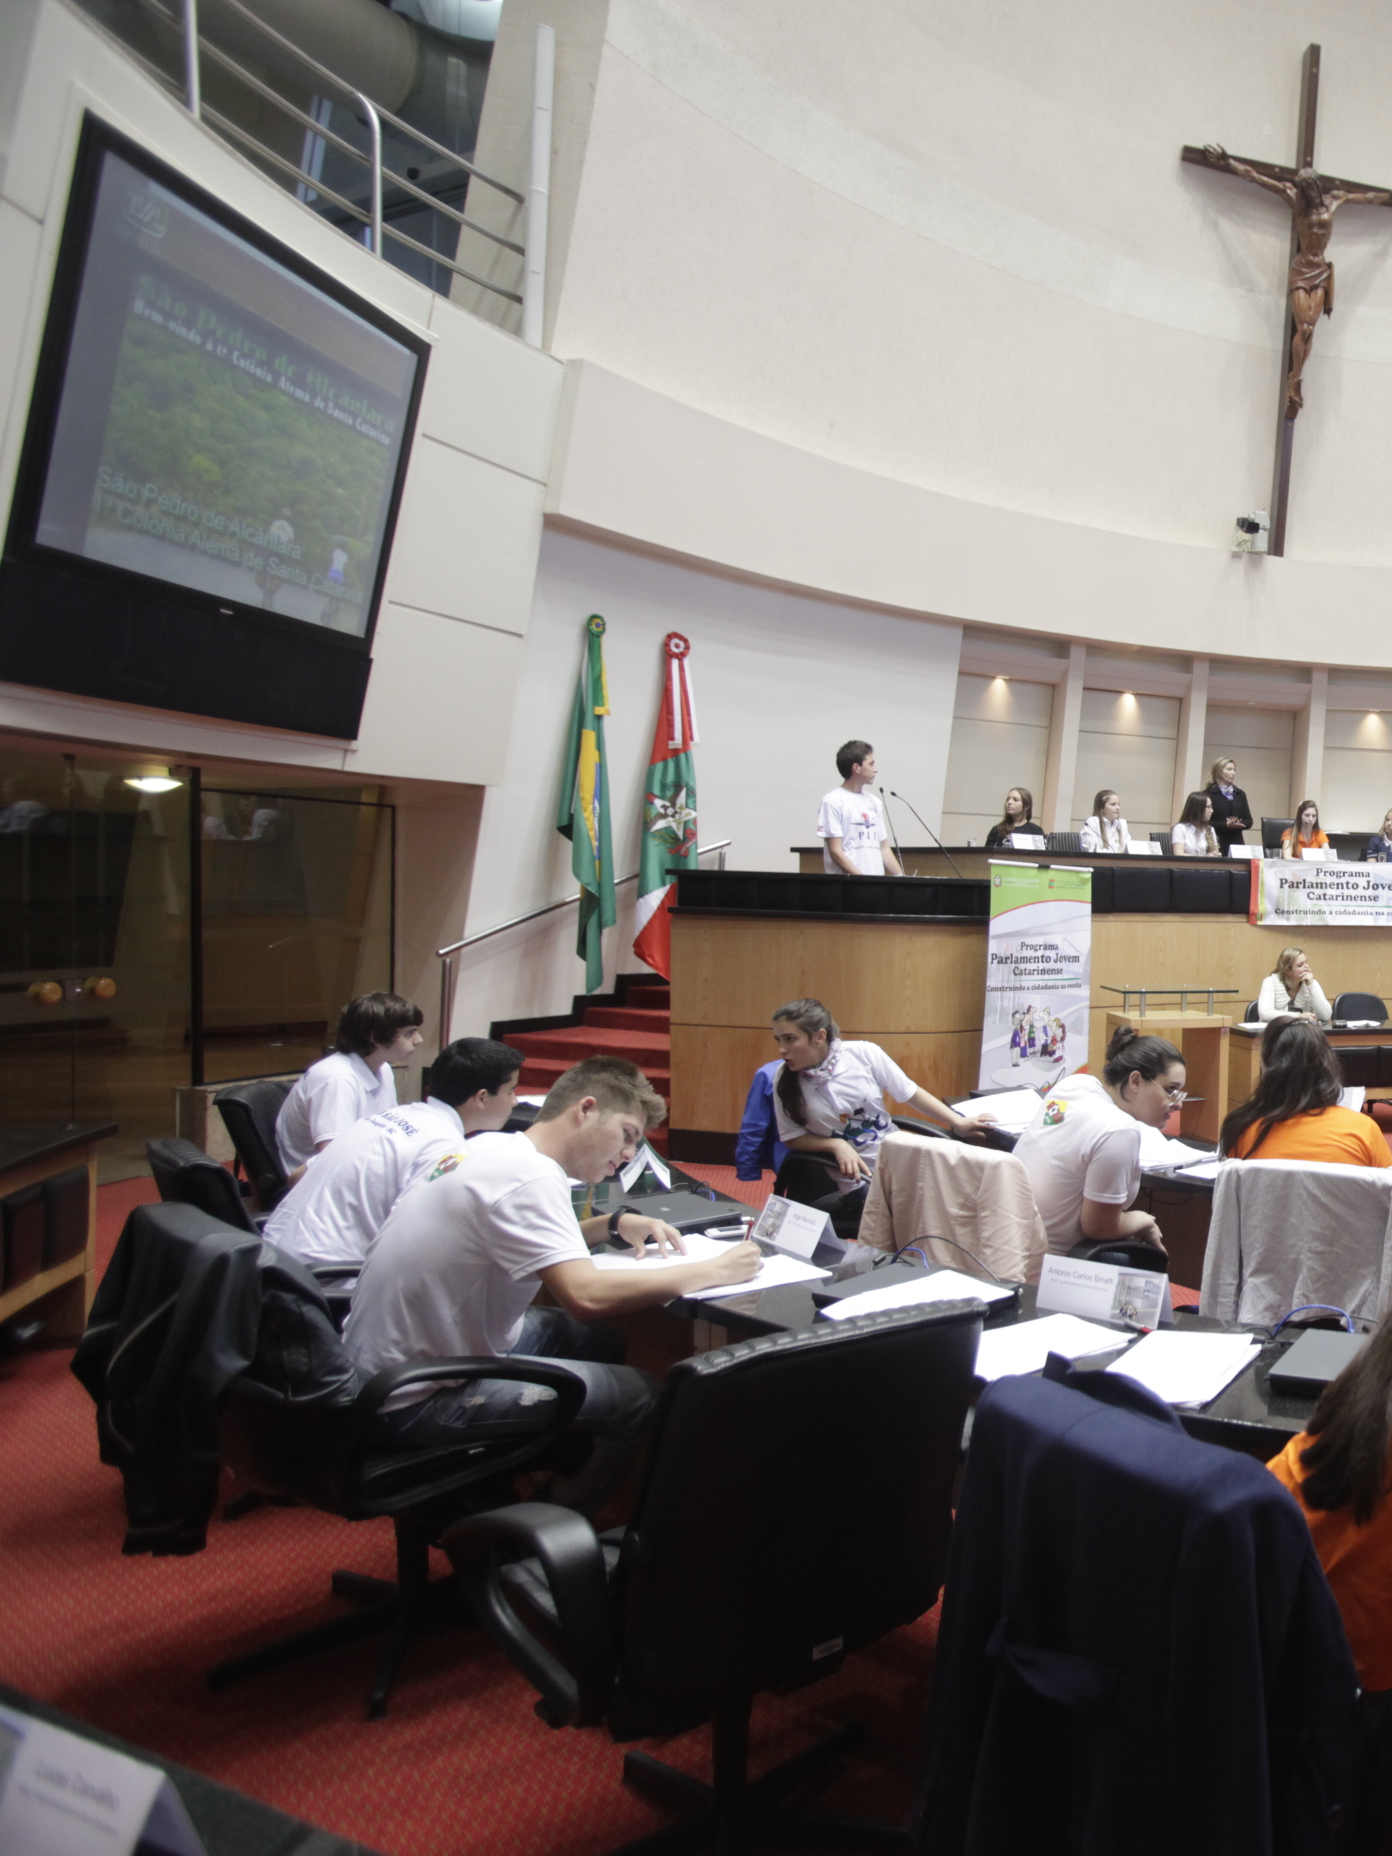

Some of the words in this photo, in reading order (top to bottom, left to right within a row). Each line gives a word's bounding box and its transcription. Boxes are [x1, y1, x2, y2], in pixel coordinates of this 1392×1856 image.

[232, 350, 273, 383] Colônia
[327, 401, 353, 425] Santa
[356, 417, 390, 445] Catarina
[99, 465, 138, 498] São
[143, 483, 199, 521] Pedro
[203, 508, 226, 530] de
[118, 505, 185, 542] Colônia
[189, 528, 240, 562] Alemã
[244, 552, 264, 570] de
[268, 558, 308, 586] Santa
[311, 574, 363, 604] Catarina
[1315, 867, 1371, 880] Programa
[1279, 877, 1359, 891] Parlamento
[1306, 891, 1380, 903] Catarinense
[1275, 908, 1327, 917] Construindo
[1334, 908, 1374, 917] cidadania
[1020, 941, 1059, 953] Programa
[990, 953, 1051, 965] Parlamento
[1053, 952, 1081, 964] Jovem
[1013, 966, 1063, 977] Catarinense
[987, 984, 1026, 993] Construindo
[1030, 983, 1060, 991] cidadania
[1047, 1266, 1072, 1278] Antonio
[1072, 1271, 1093, 1282] Carlos
